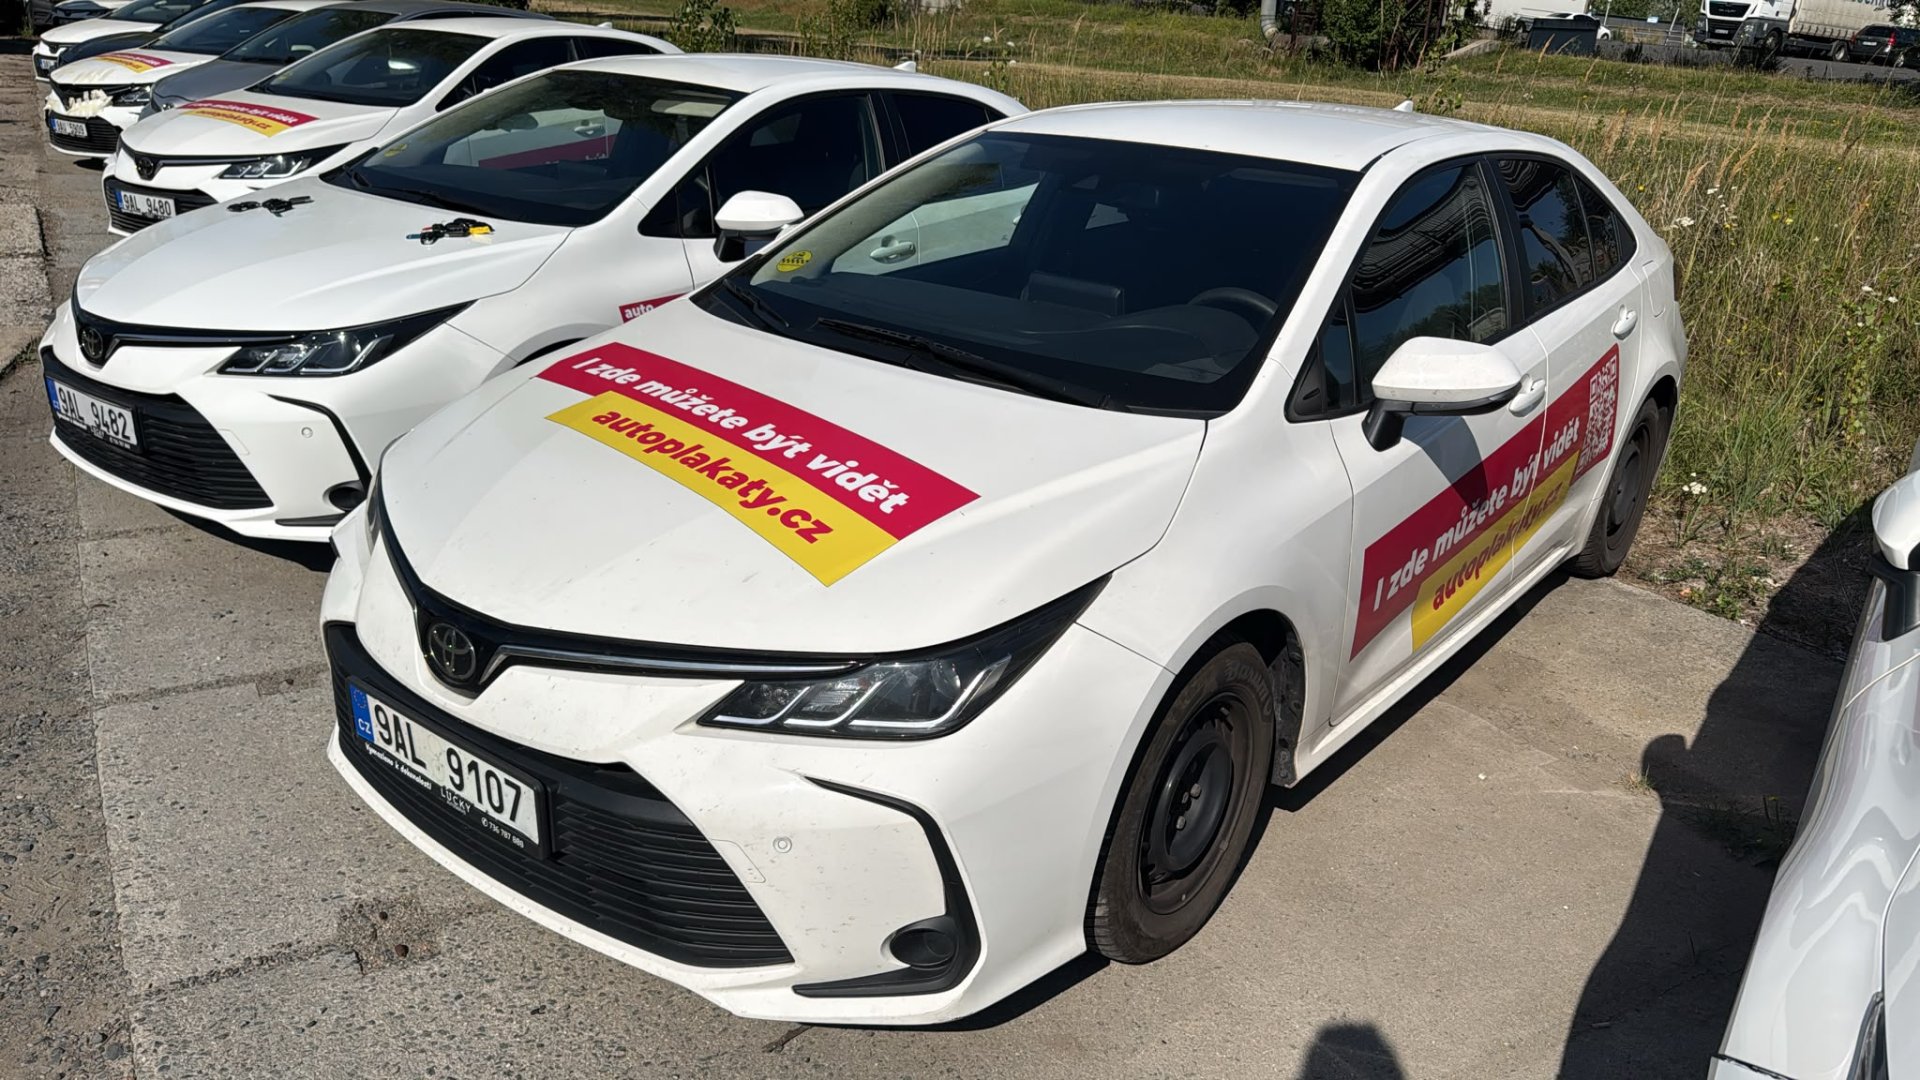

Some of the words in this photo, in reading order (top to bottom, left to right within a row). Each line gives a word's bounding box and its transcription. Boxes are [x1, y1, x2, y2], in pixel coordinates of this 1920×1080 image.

[123, 193, 141, 213] 9AL
[145, 197, 172, 216] 9480
[58, 387, 85, 422] 9AL
[90, 401, 131, 441] 9482
[571, 357, 589, 371] I
[585, 359, 642, 385] zde
[633, 380, 749, 431] můžete
[742, 423, 813, 459] být
[805, 453, 910, 515] vidět
[591, 408, 835, 545] autoplakaty.cz
[1372, 577, 1386, 612] I
[1386, 545, 1429, 601] zde
[1432, 484, 1508, 562] můžete
[1510, 452, 1541, 499] být
[1541, 416, 1581, 470] vidět
[1431, 481, 1565, 612] autoplakaty.cz
[358, 718, 372, 734] CZ
[374, 704, 428, 770] 9AL
[446, 747, 523, 823] 9107
[440, 786, 472, 813] LUCKY
